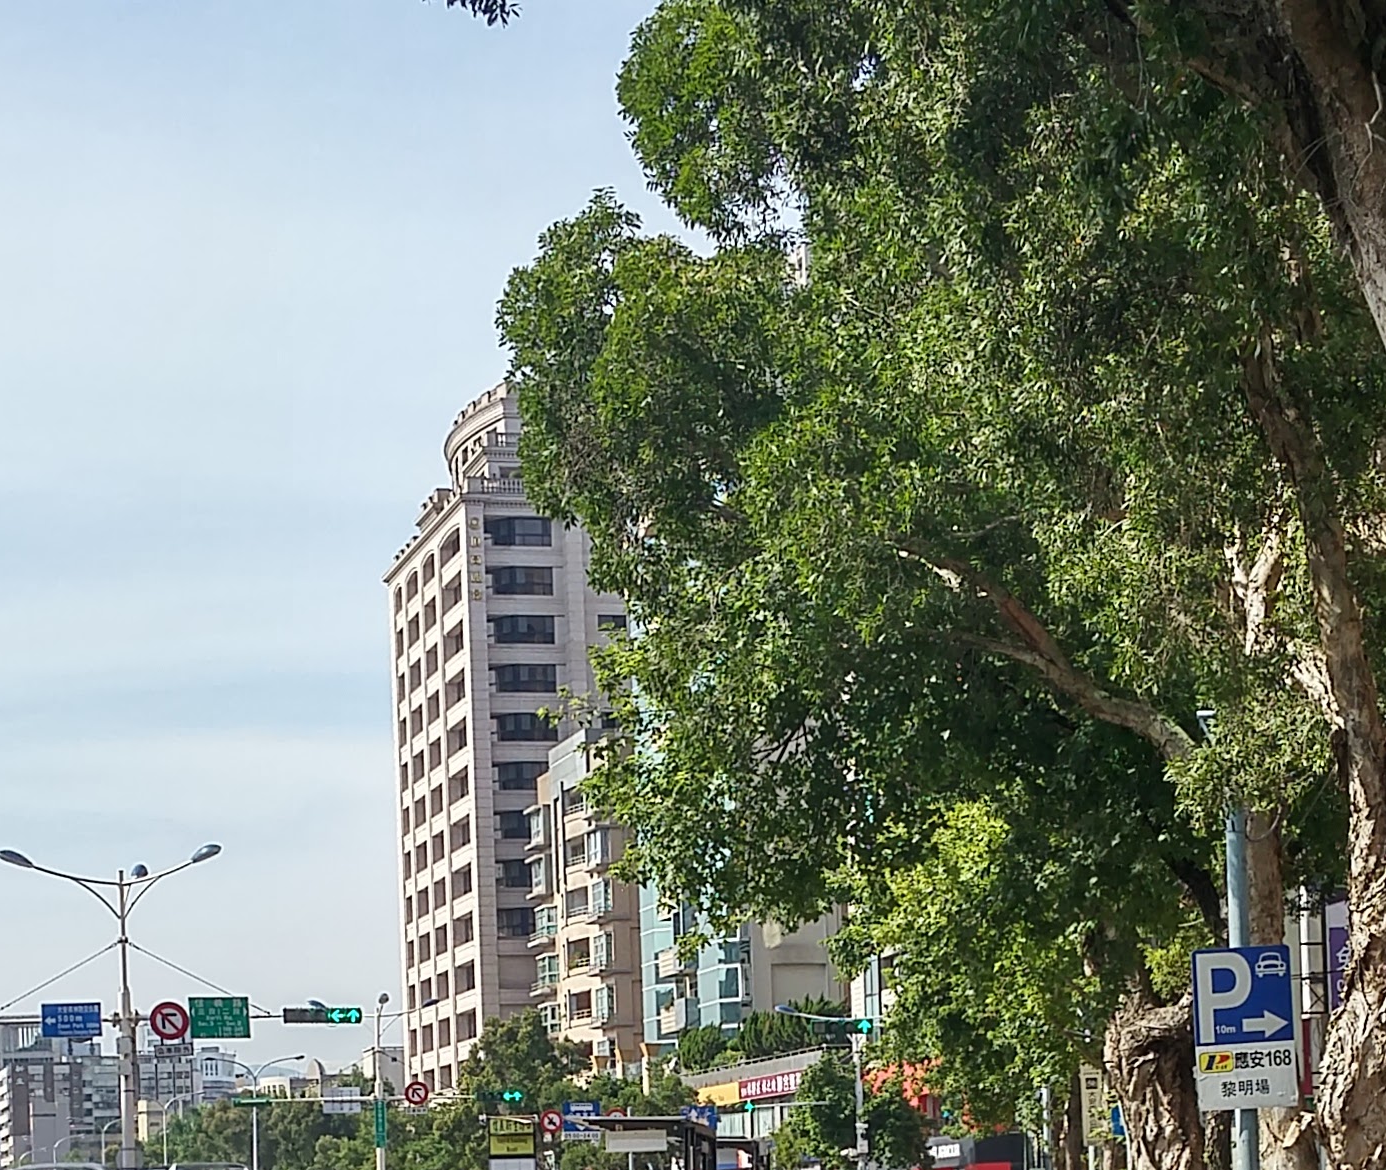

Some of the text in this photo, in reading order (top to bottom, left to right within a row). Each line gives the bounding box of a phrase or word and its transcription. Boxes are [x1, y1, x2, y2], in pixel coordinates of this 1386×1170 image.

[1196, 952, 1252, 1044] P
[1215, 1025, 1237, 1035] 10m
[1234, 1049, 1292, 1069] 應安168
[1221, 1078, 1270, 1098] 黎明場
